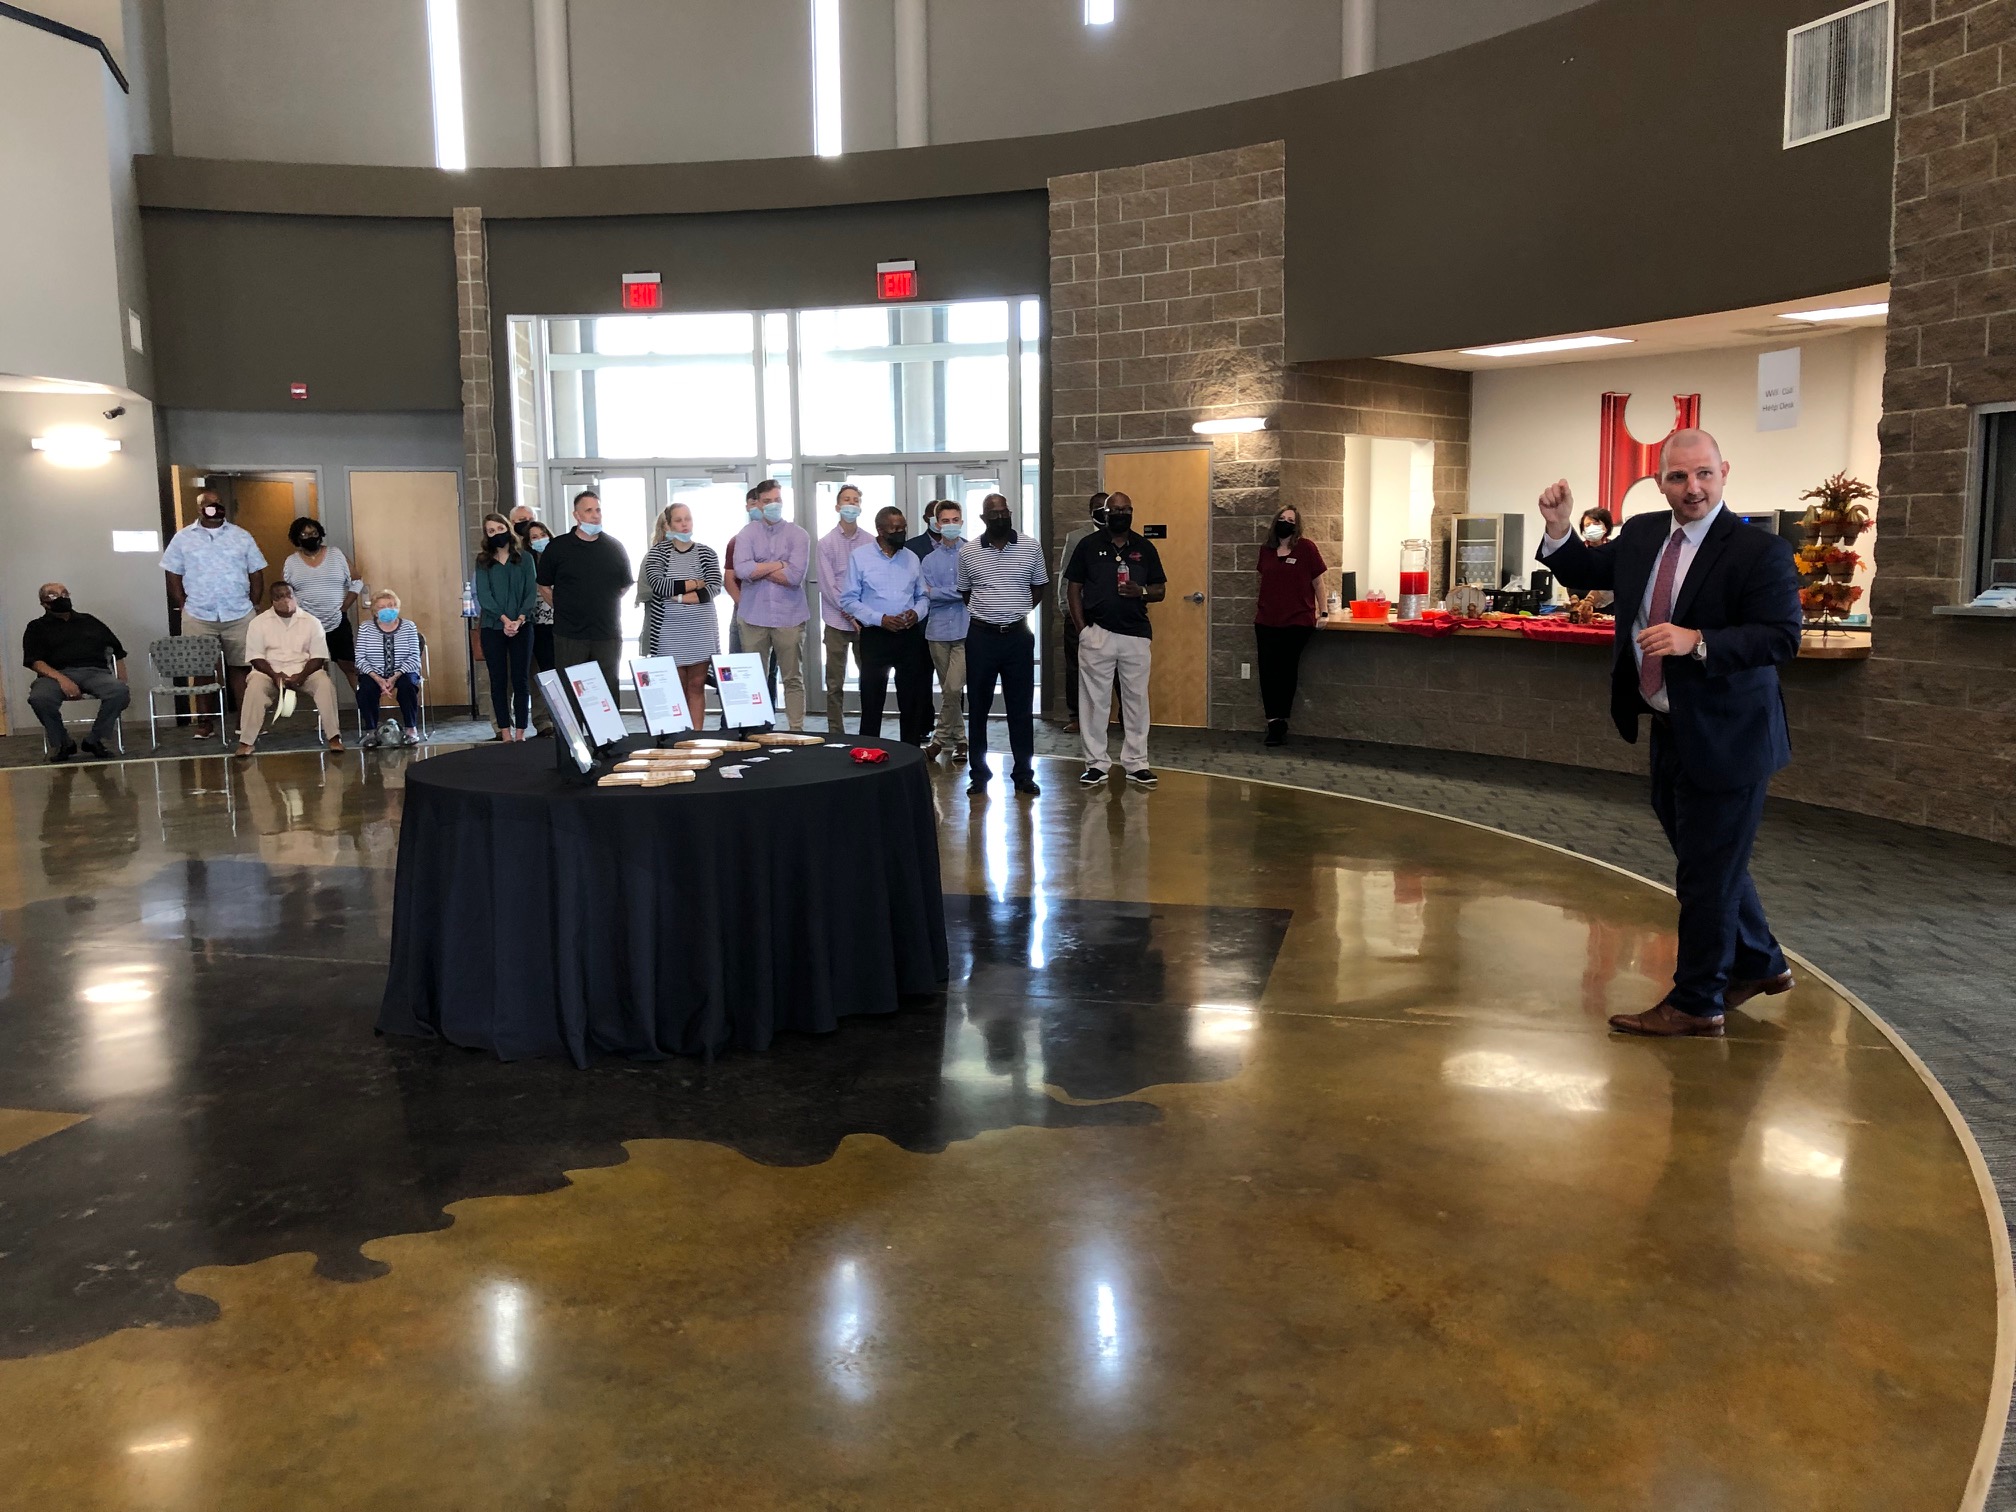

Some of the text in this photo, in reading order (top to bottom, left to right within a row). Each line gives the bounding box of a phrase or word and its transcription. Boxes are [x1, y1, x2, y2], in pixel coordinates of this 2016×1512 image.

[630, 284, 657, 307] EXIT
[884, 272, 912, 297] EXIT
[1762, 401, 1795, 412] Help Desk
